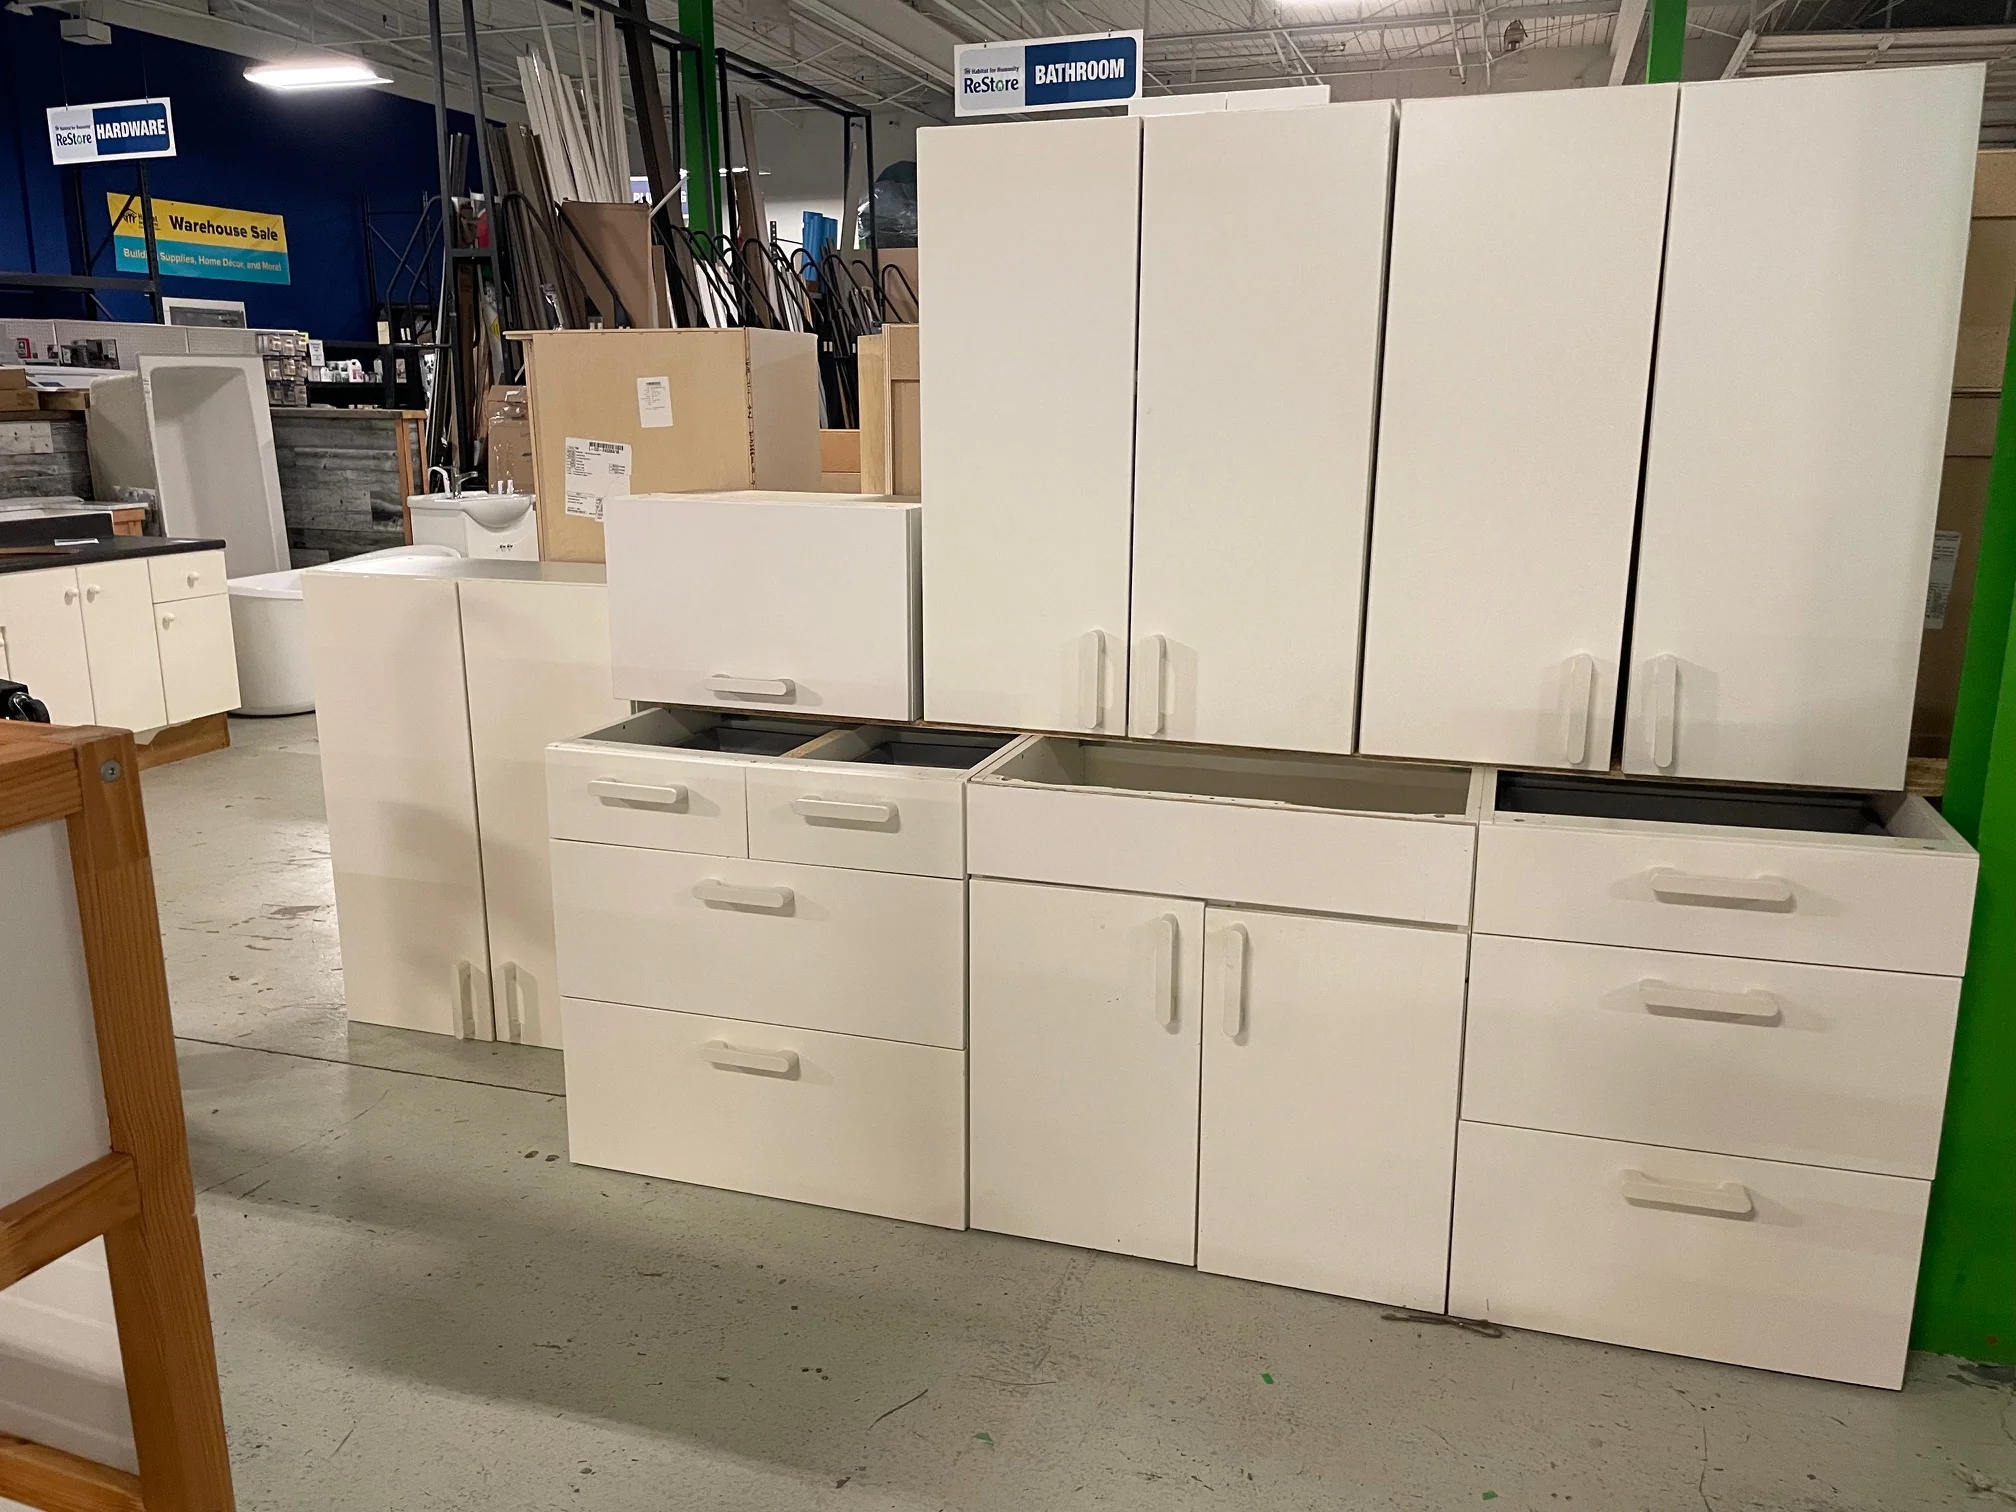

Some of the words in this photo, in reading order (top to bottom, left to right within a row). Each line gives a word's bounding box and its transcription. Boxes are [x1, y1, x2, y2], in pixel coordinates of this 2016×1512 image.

[1035, 58, 1125, 85] BATHROOM
[964, 76, 1019, 94] ReStore
[96, 119, 166, 140] HARDWARE
[55, 132, 92, 147] ReStore
[169, 215, 248, 238] Warehouse
[250, 225, 278, 241] Sale
[160, 252, 197, 265] Supplies,
[198, 255, 221, 266] Home
[247, 262, 262, 270] and
